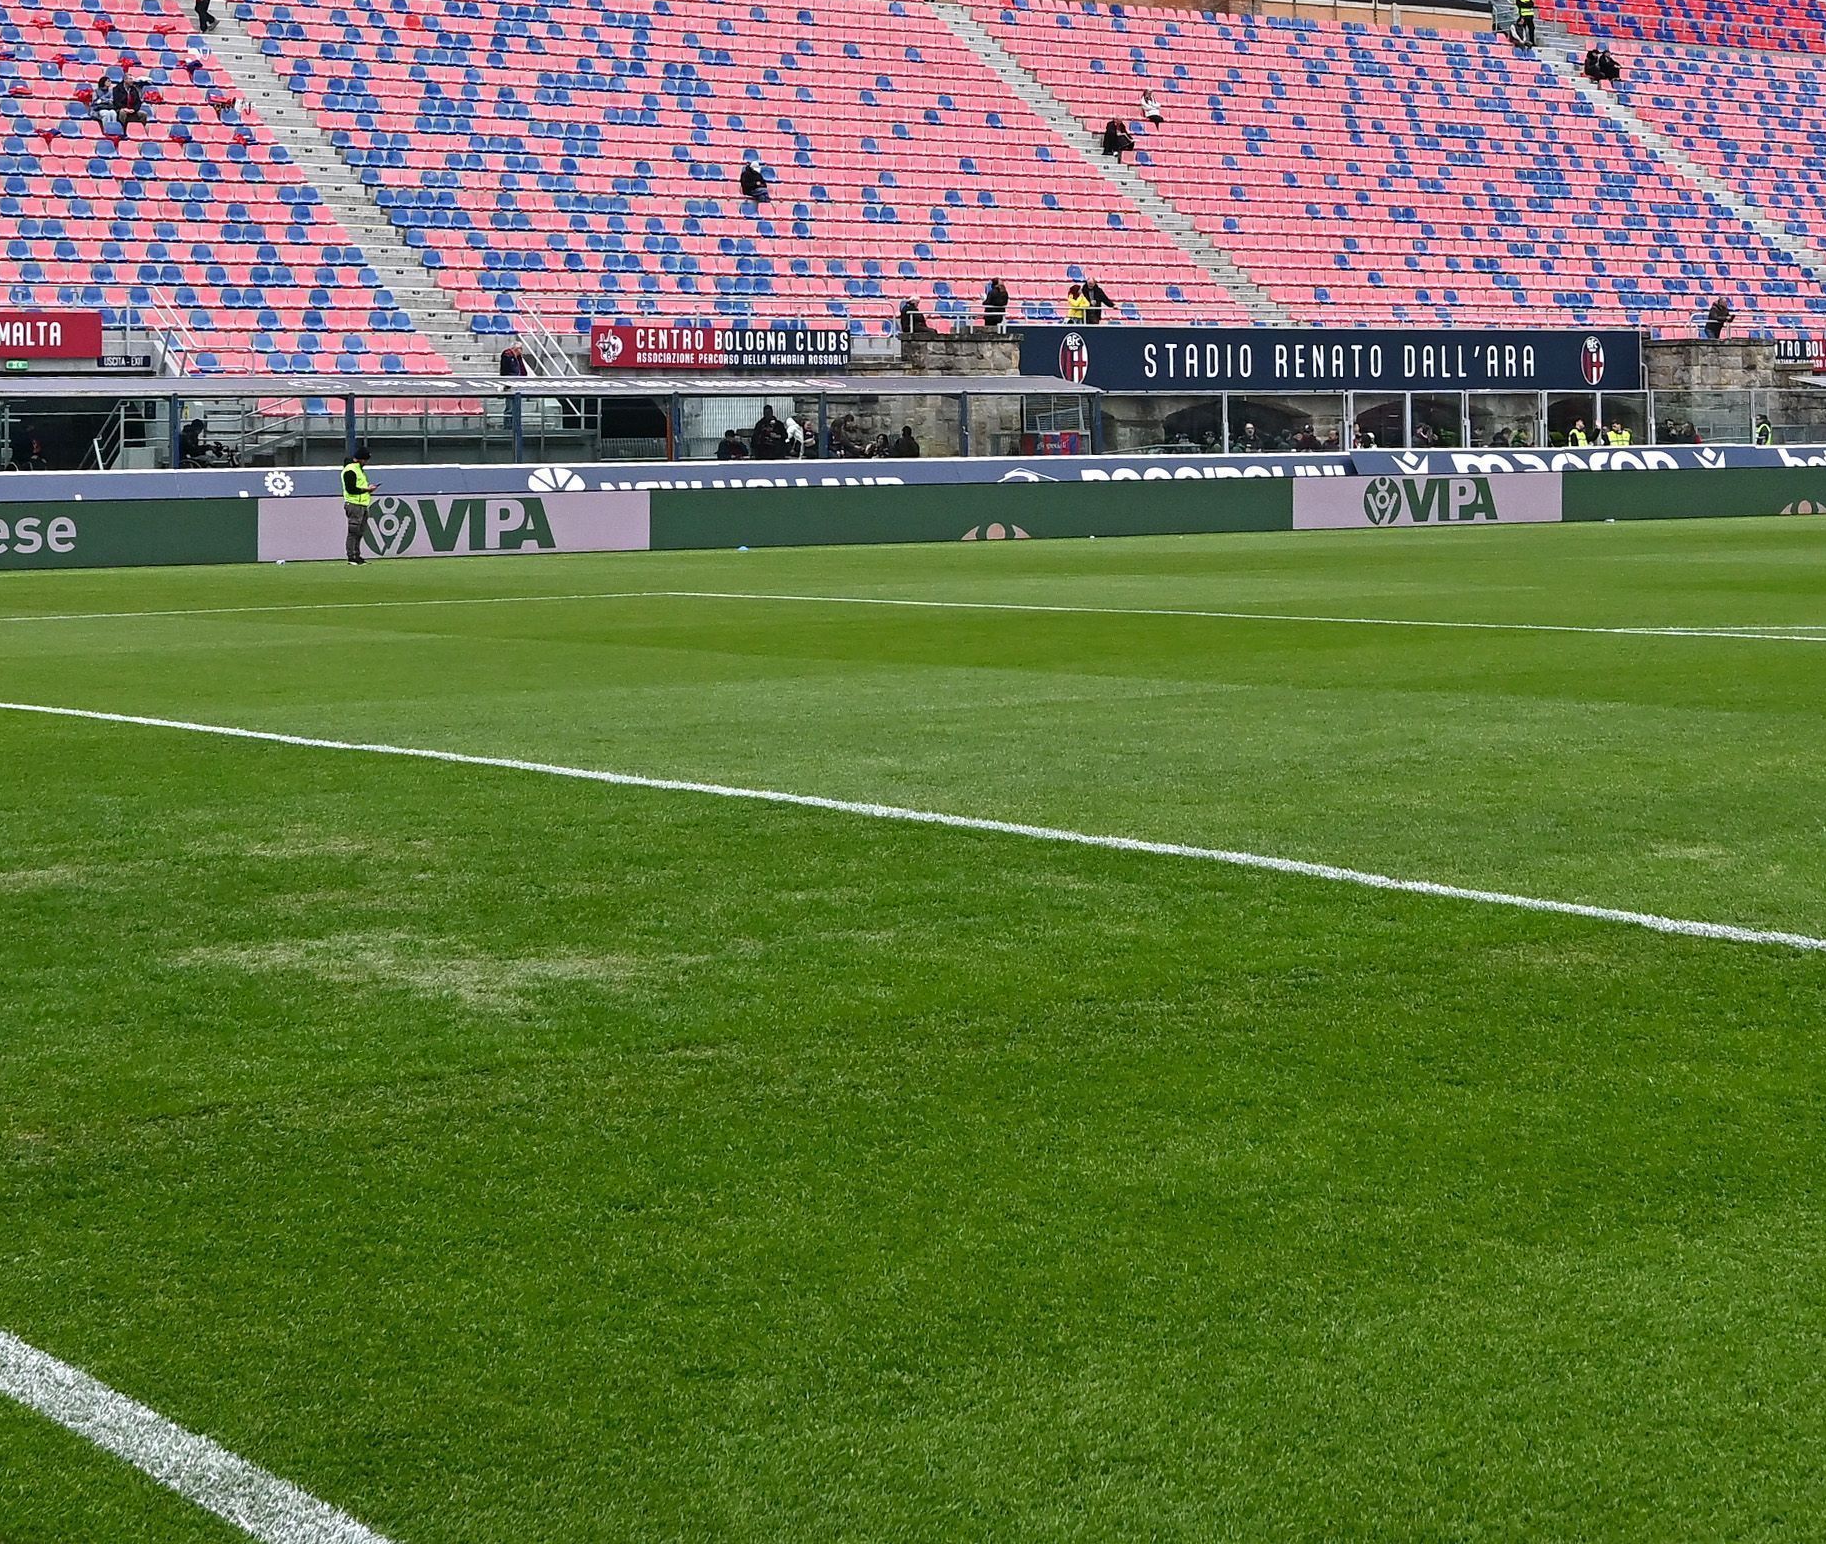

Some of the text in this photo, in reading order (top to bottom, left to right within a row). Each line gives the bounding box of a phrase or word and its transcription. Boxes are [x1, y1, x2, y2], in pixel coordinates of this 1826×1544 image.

[636, 329, 849, 352] CENTRO BOLOGNA CLUBS
[104, 357, 144, 367] USCITA EXIT
[637, 352, 695, 364] ASSOCIAZIONE
[699, 353, 739, 365] PERCORSO
[743, 354, 766, 365] DELLA
[770, 354, 805, 365] MEMORIA
[1144, 343, 1535, 378] STADIO RENATO DALL'ARA
[1402, 477, 1499, 521] VIPA
[417, 498, 556, 552] VIPA
